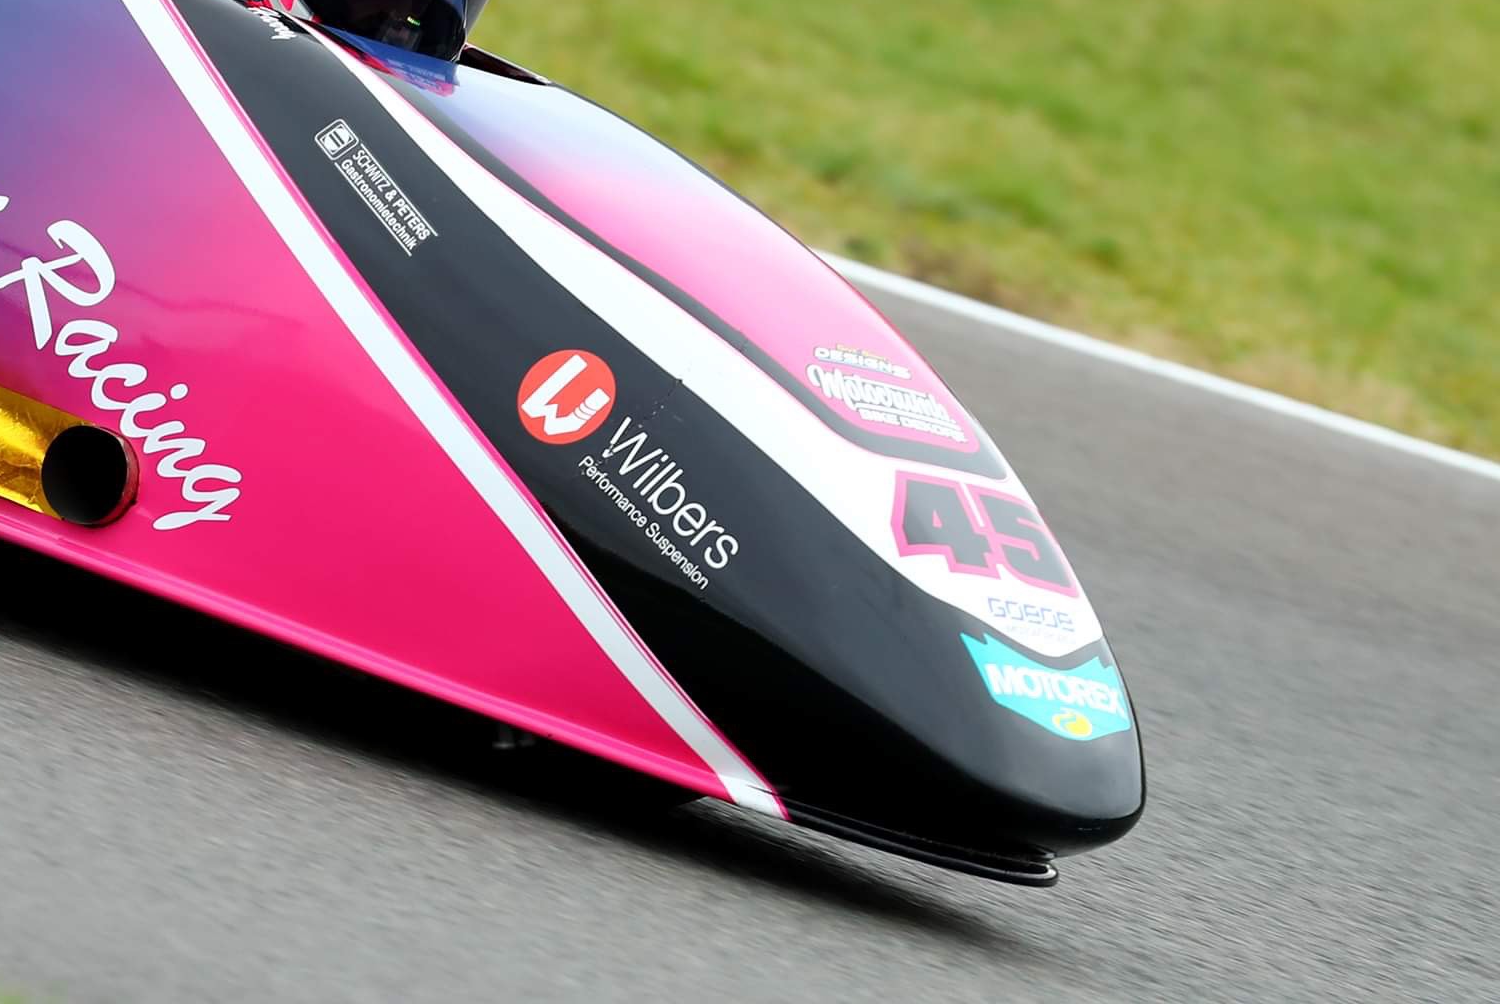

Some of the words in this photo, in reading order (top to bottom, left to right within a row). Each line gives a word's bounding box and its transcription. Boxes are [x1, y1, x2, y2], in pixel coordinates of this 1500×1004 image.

[353, 150, 391, 192] SCHMITZ
[385, 189, 397, 202] &
[392, 198, 430, 241] PETERS
[578, 455, 647, 528] Performance
[645, 522, 709, 590] Suspension
[602, 416, 739, 569] Wilbers
[891, 470, 1079, 598] 45
[984, 663, 1126, 716] MOTOREX
